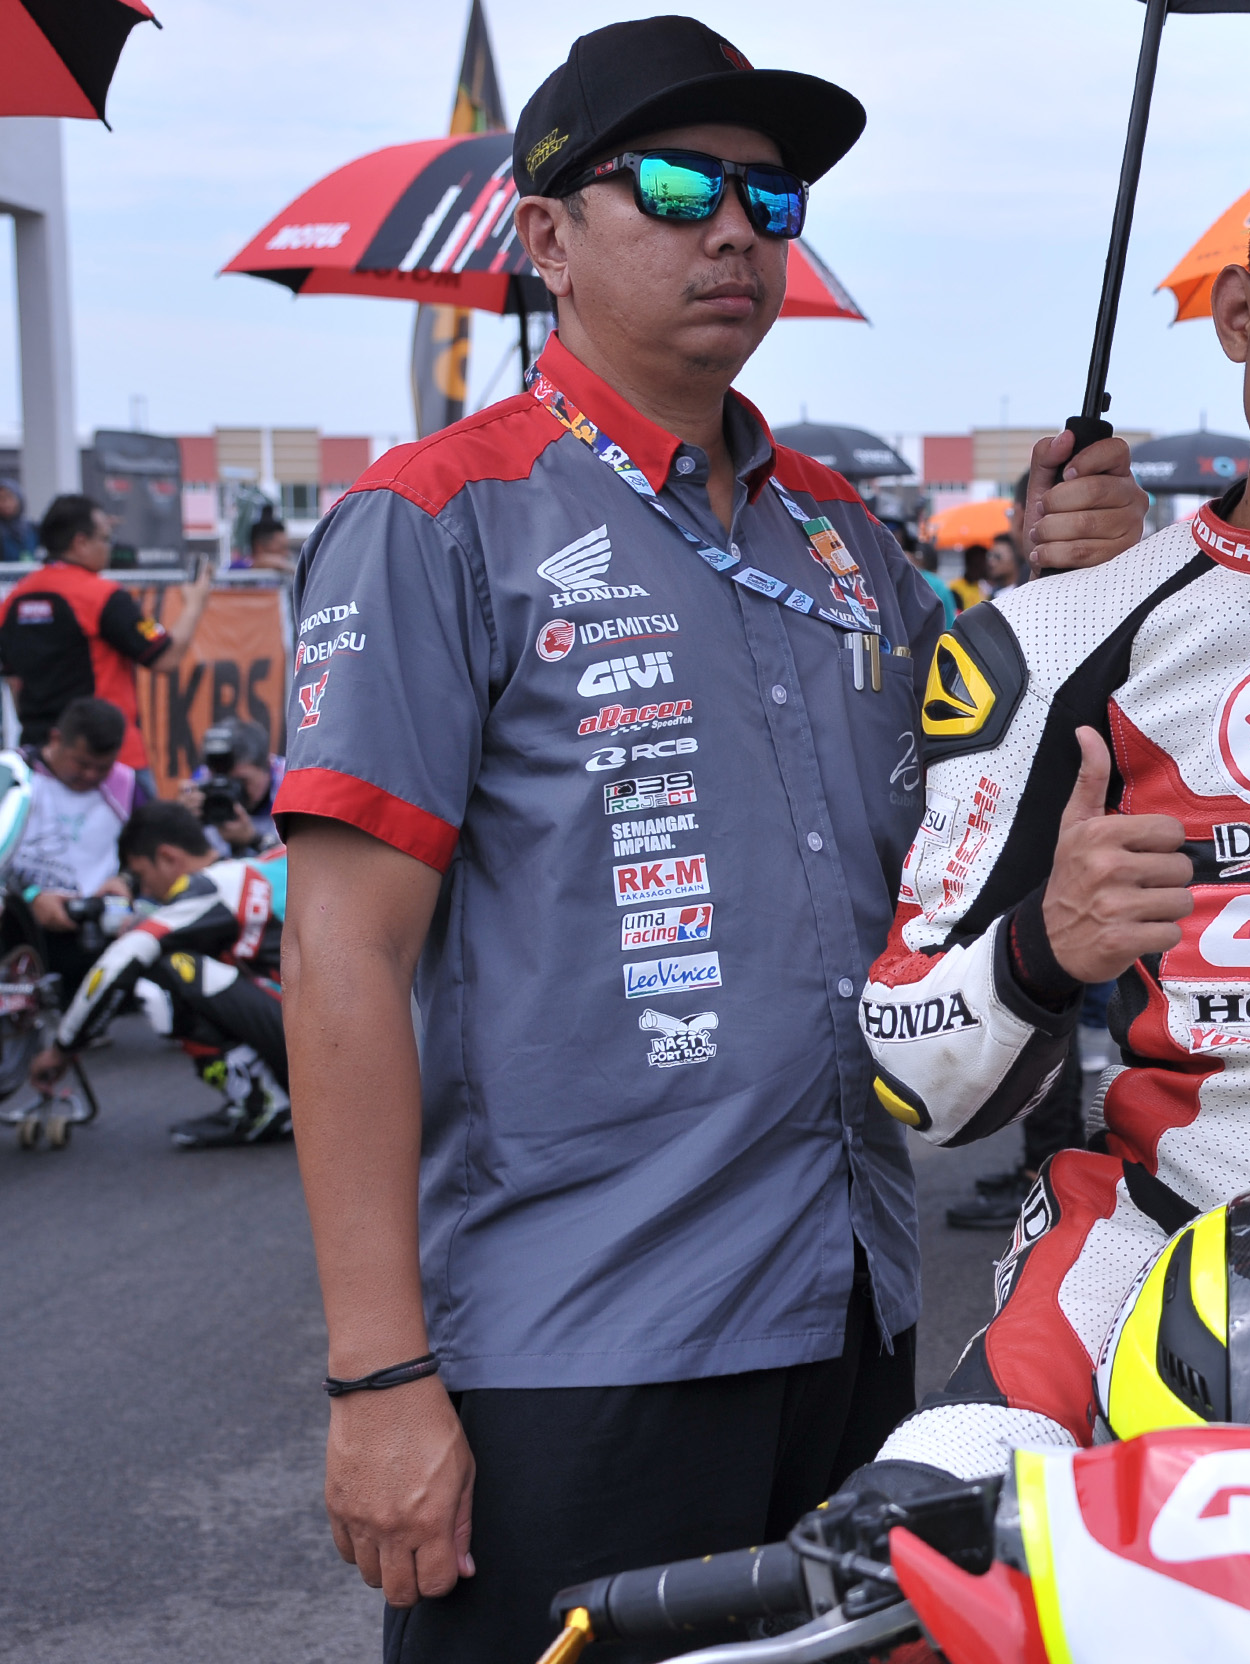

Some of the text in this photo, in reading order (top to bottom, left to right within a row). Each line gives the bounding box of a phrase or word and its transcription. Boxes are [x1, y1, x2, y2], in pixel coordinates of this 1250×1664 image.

[266, 222, 350, 250] MOTUL
[549, 584, 651, 609] HONDA
[300, 600, 360, 636] HONDA
[579, 613, 680, 645] IDEMITSU
[576, 651, 675, 698] GIVI
[631, 737, 699, 762] RCB
[611, 813, 699, 840] SEMANGAT.
[613, 833, 676, 857] IMPIAN.
[617, 858, 704, 894] RK-M
[620, 884, 705, 903] TAKASAGO CHAIN
[624, 911, 665, 930] uma
[624, 925, 678, 946] racing
[627, 961, 719, 992] LeoVince
[862, 991, 978, 1039] HONDA
[650, 1050, 681, 1063] PORT
[683, 1045, 716, 1058] FLOW
[653, 1035, 710, 1053] NASTY
